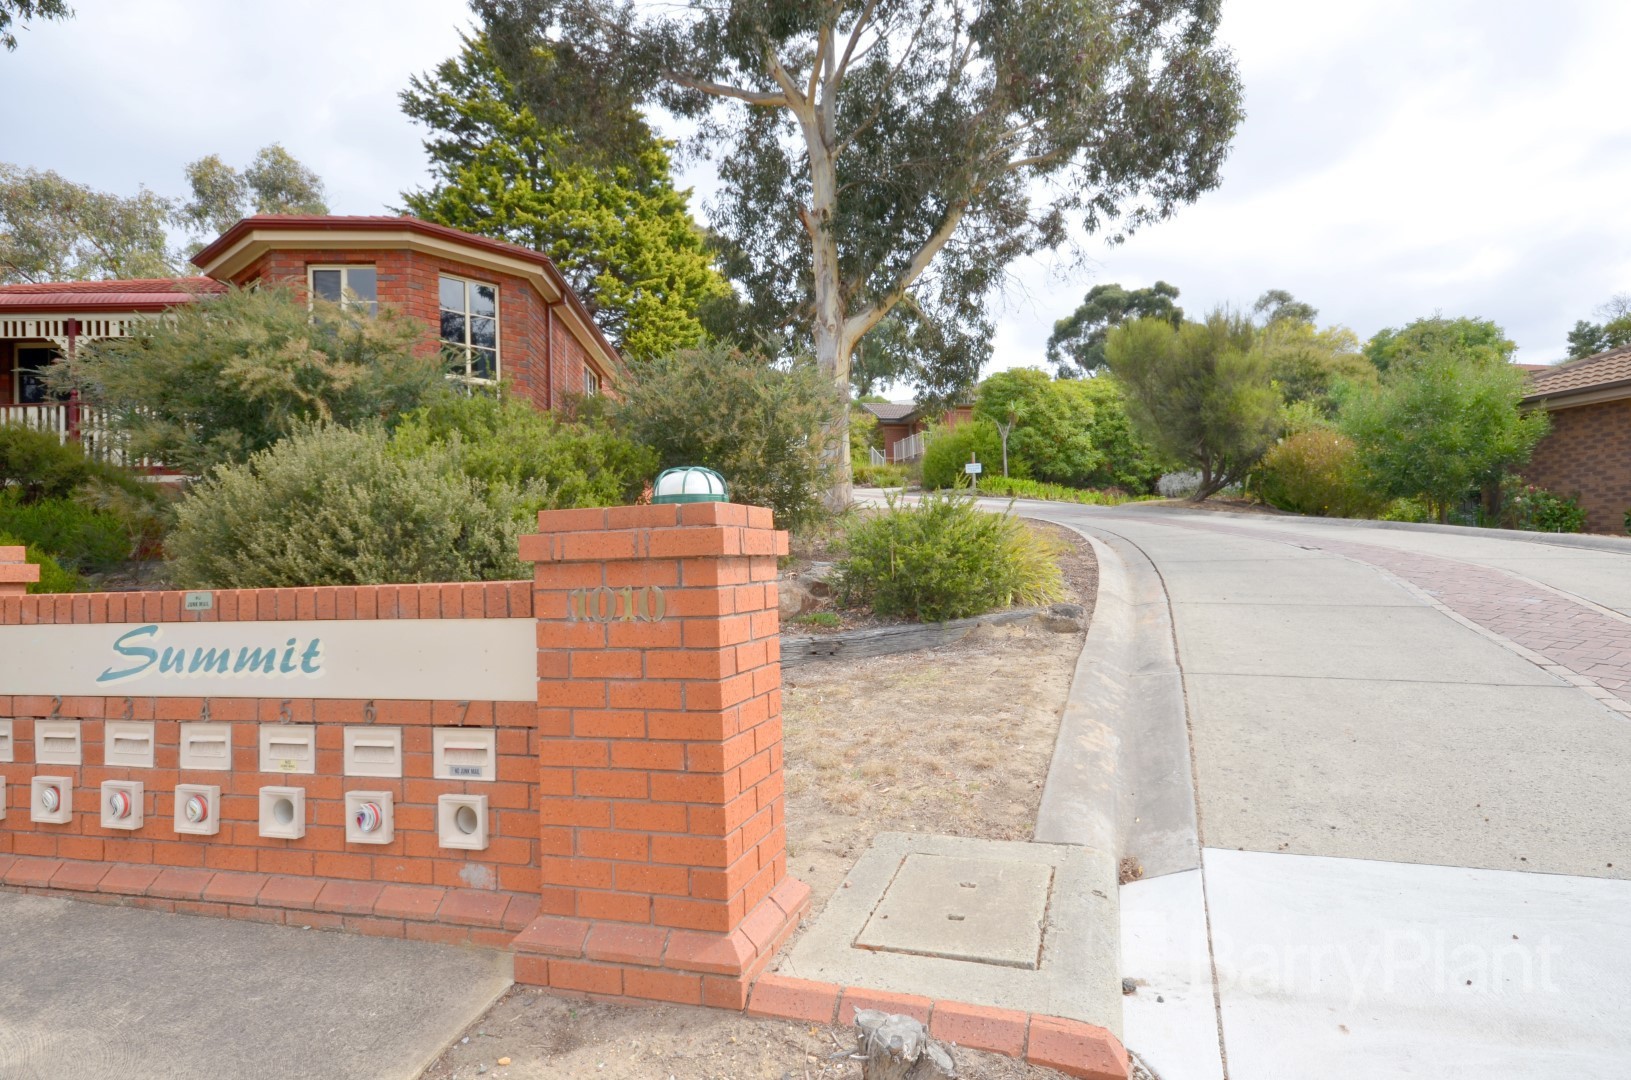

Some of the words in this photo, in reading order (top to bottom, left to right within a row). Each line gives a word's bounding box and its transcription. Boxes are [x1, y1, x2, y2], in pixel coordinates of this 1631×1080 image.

[570, 585, 666, 623] 1010
[95, 624, 322, 684] Summit
[50, 694, 63, 719] 2
[122, 696, 134, 720] 3
[200, 697, 212, 723] 4
[279, 699, 292, 725] 5
[363, 700, 377, 724] 6
[456, 700, 470, 727] 7
